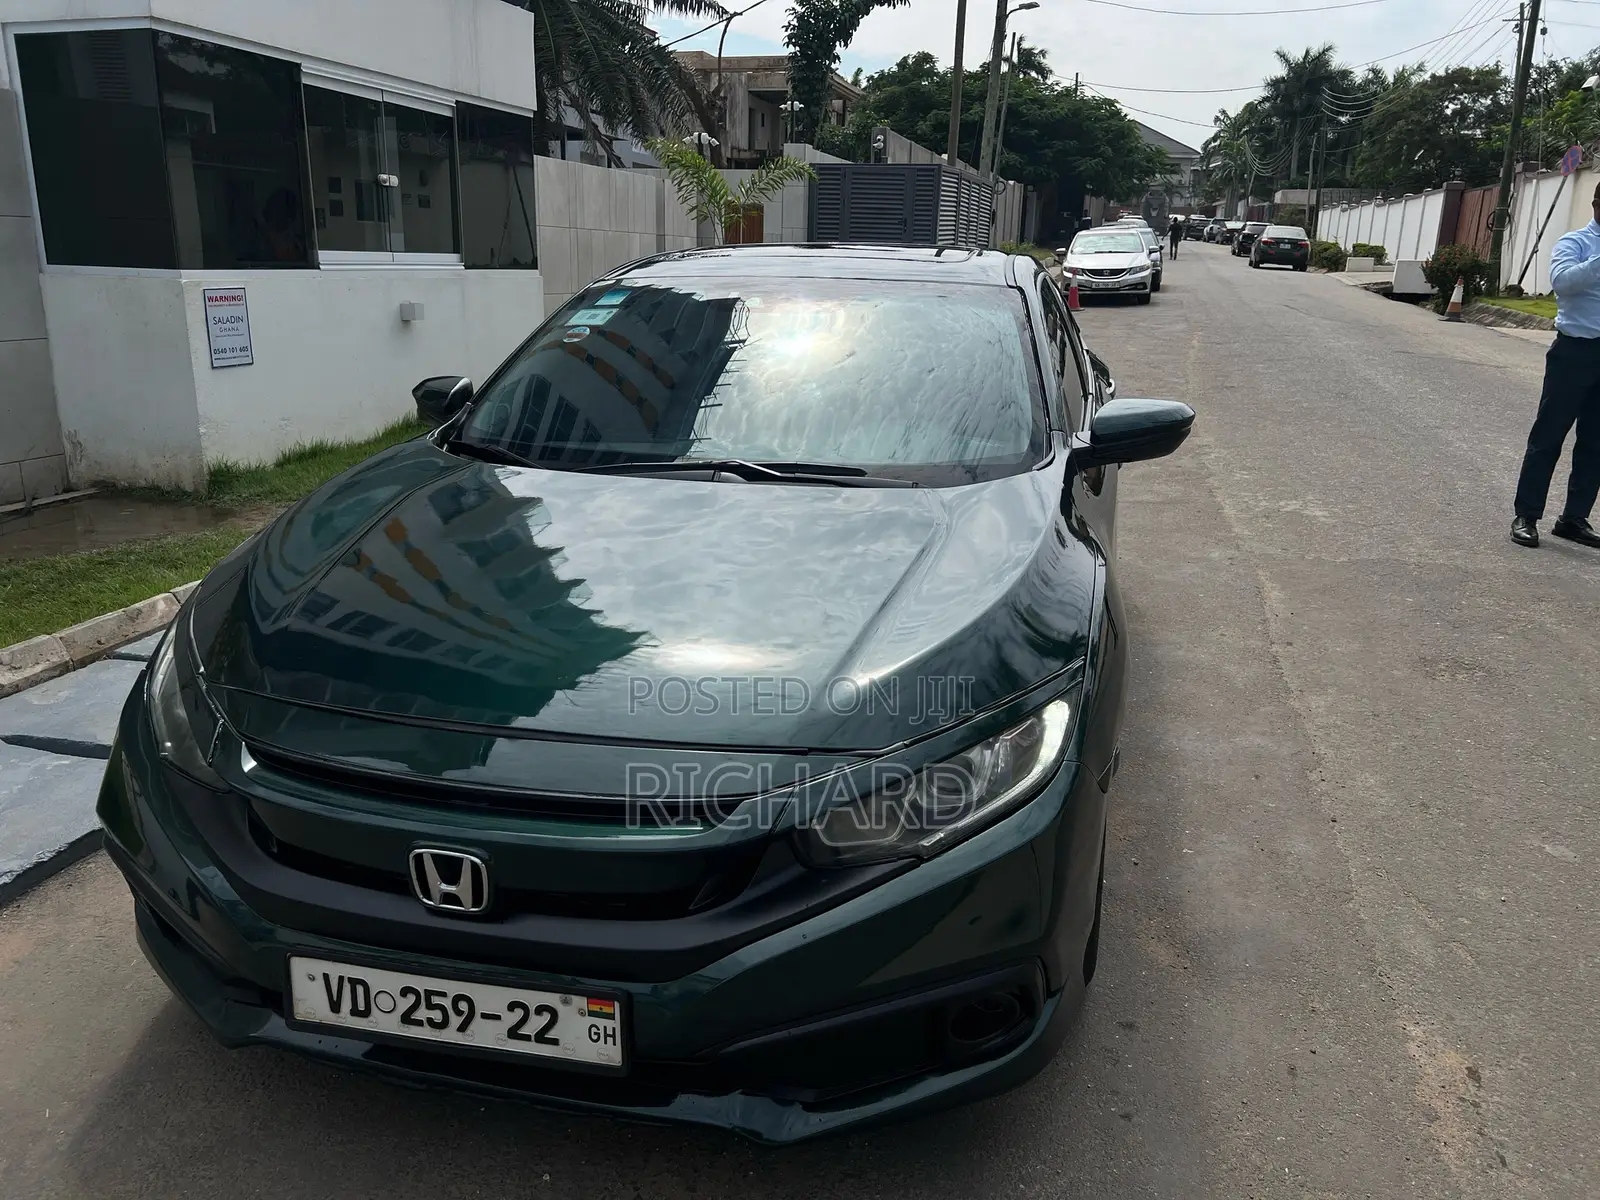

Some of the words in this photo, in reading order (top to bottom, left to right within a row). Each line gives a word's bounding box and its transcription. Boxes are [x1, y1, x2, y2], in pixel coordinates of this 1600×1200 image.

[213, 316, 243, 325] SALADIN
[213, 347, 228, 355] 0540
[228, 346, 238, 354] 101
[587, 1023, 617, 1046] GH
